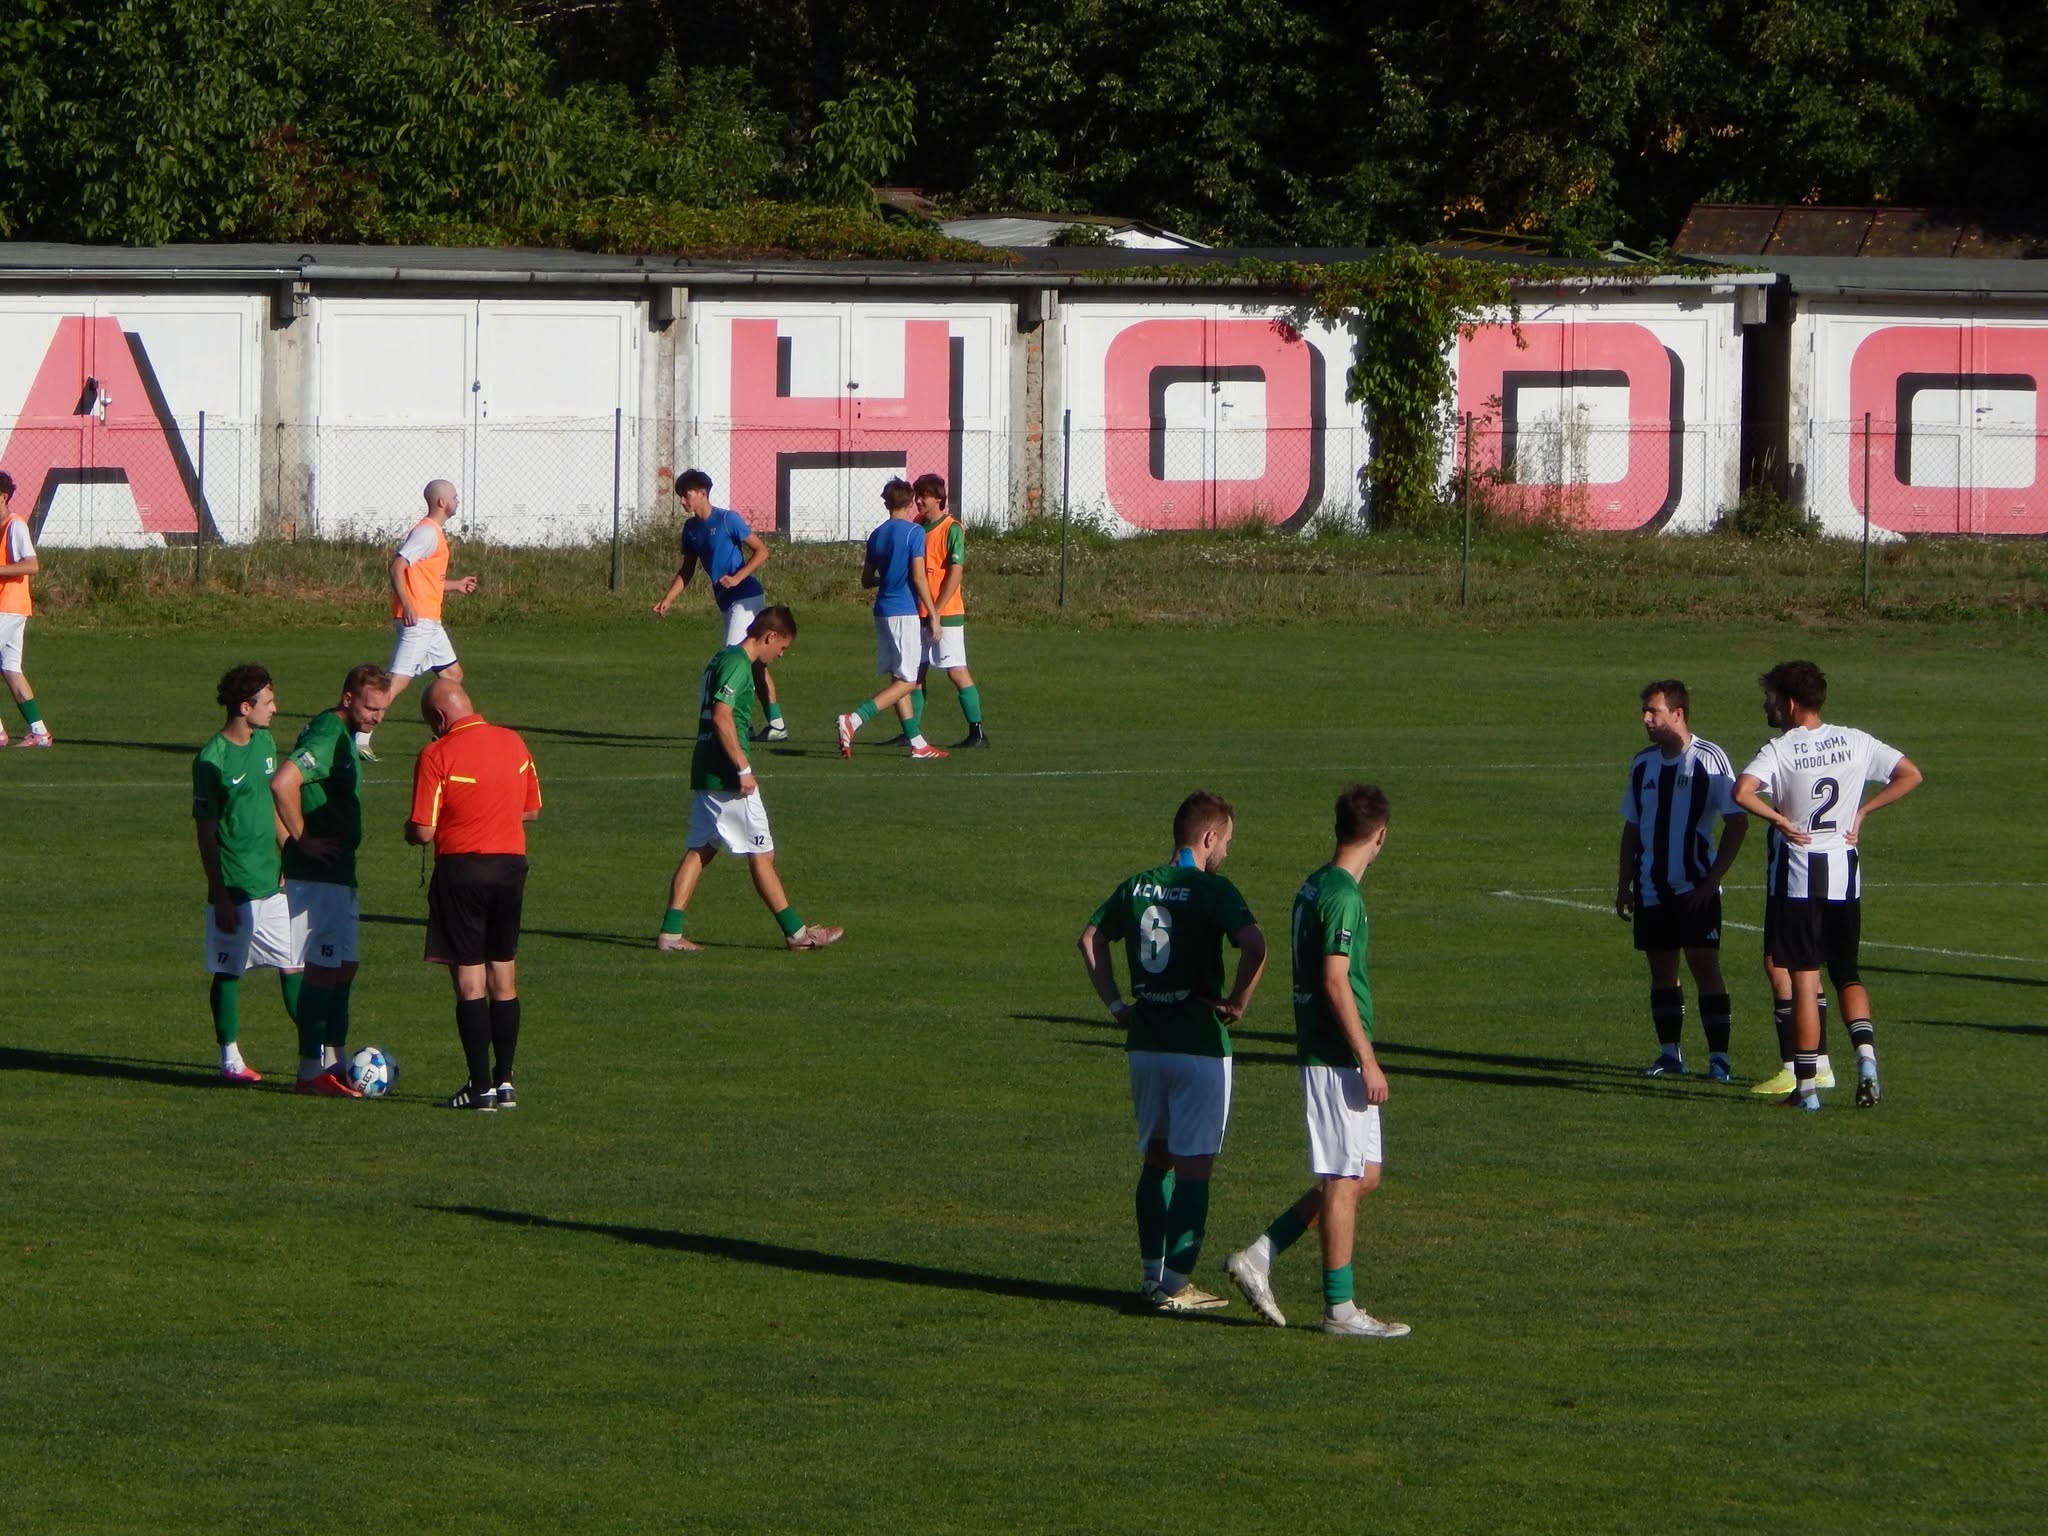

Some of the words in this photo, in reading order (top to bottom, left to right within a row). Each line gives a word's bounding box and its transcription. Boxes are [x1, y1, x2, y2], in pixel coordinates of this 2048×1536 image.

[1793, 742, 1809, 755] FC
[1815, 735, 1848, 752] SIGMA
[1794, 749, 1853, 770] HODOLANY
[1807, 776, 1840, 834] 2
[754, 834, 765, 846] 12
[1140, 904, 1173, 974] 6
[216, 951, 229, 964] 17
[320, 944, 334, 957] 15
